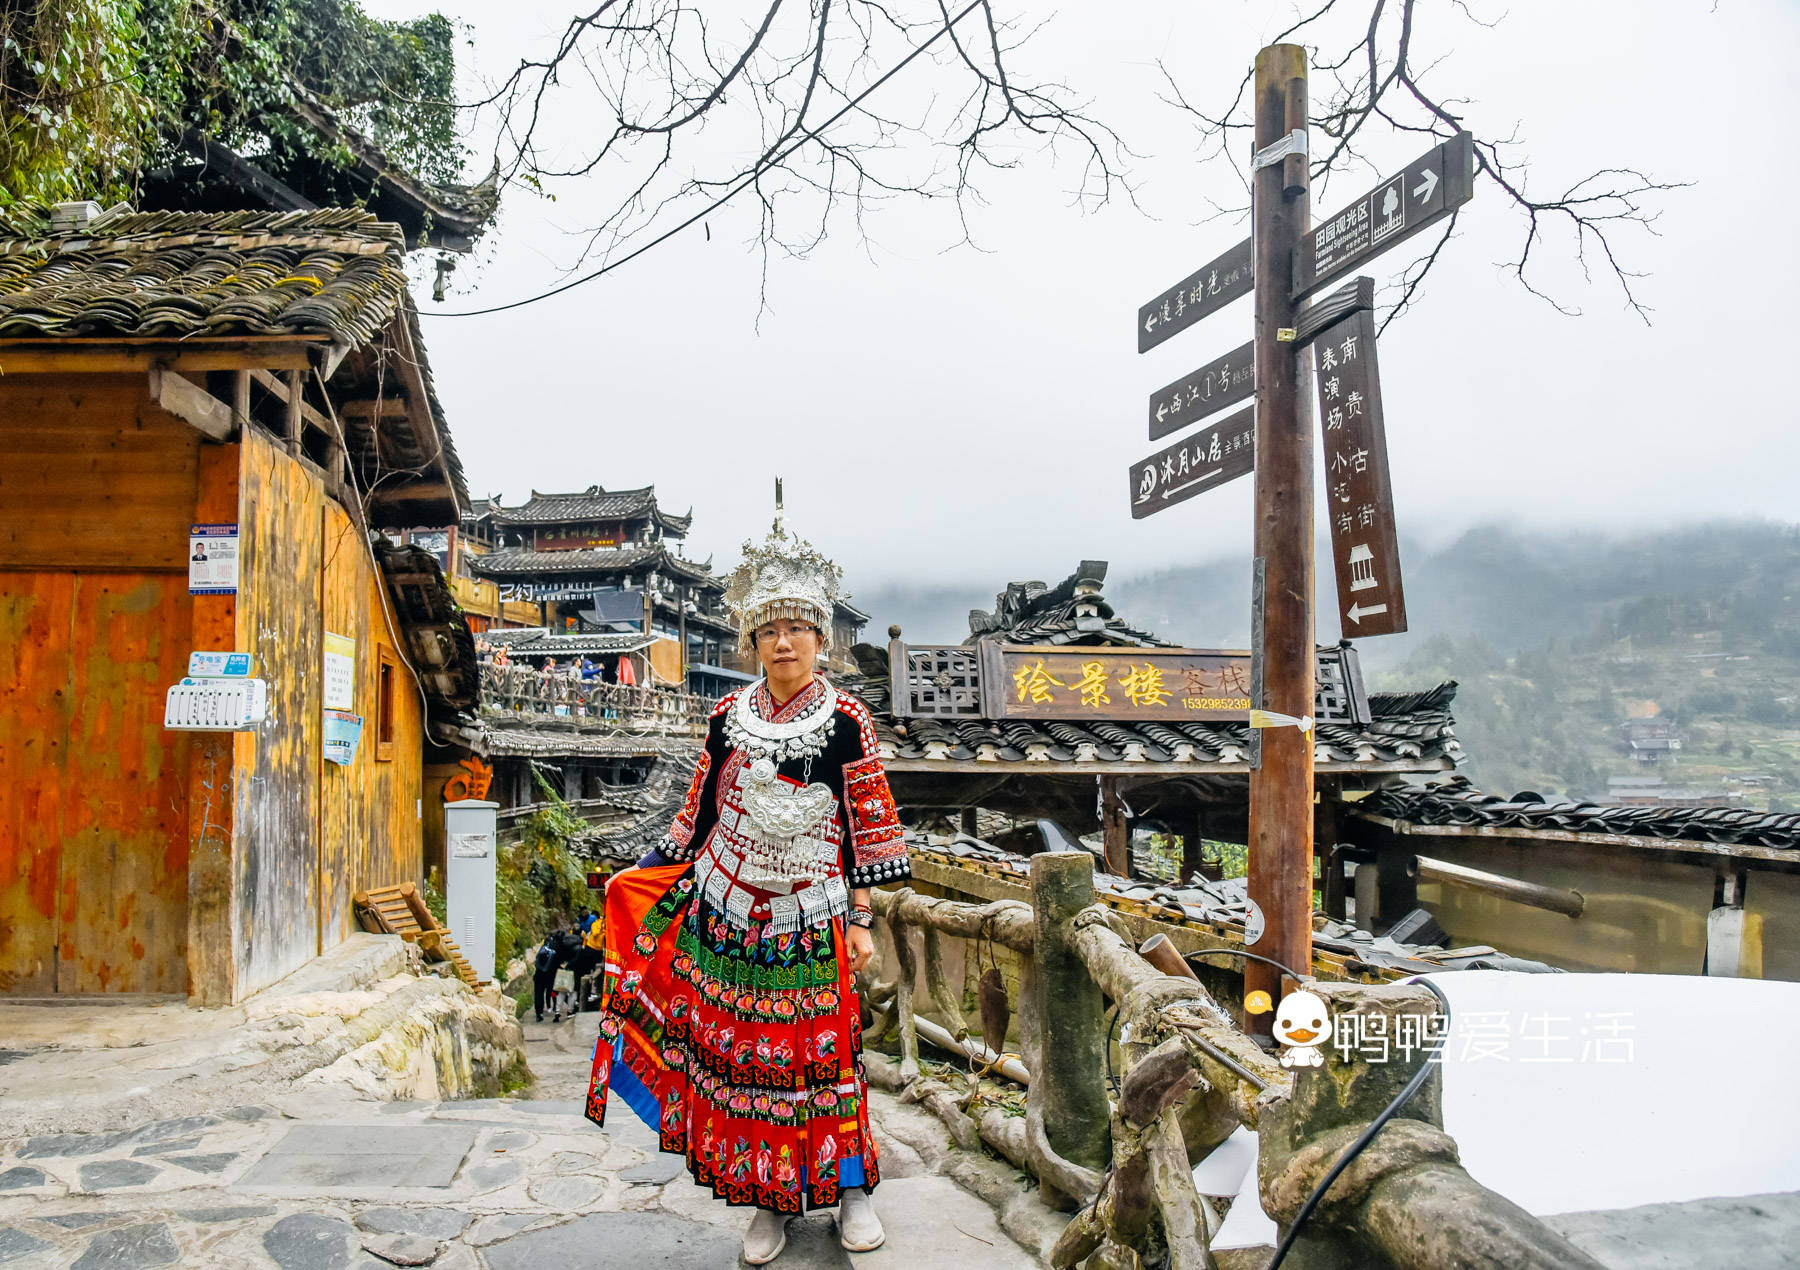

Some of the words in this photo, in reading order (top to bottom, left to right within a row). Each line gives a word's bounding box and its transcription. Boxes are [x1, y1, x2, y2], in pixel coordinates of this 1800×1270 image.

[1315, 200, 1369, 251] 田园观光区
[1321, 347, 1344, 431] 表演场
[1012, 660, 1174, 709] 绘景楼
[1180, 663, 1252, 697] 客栈
